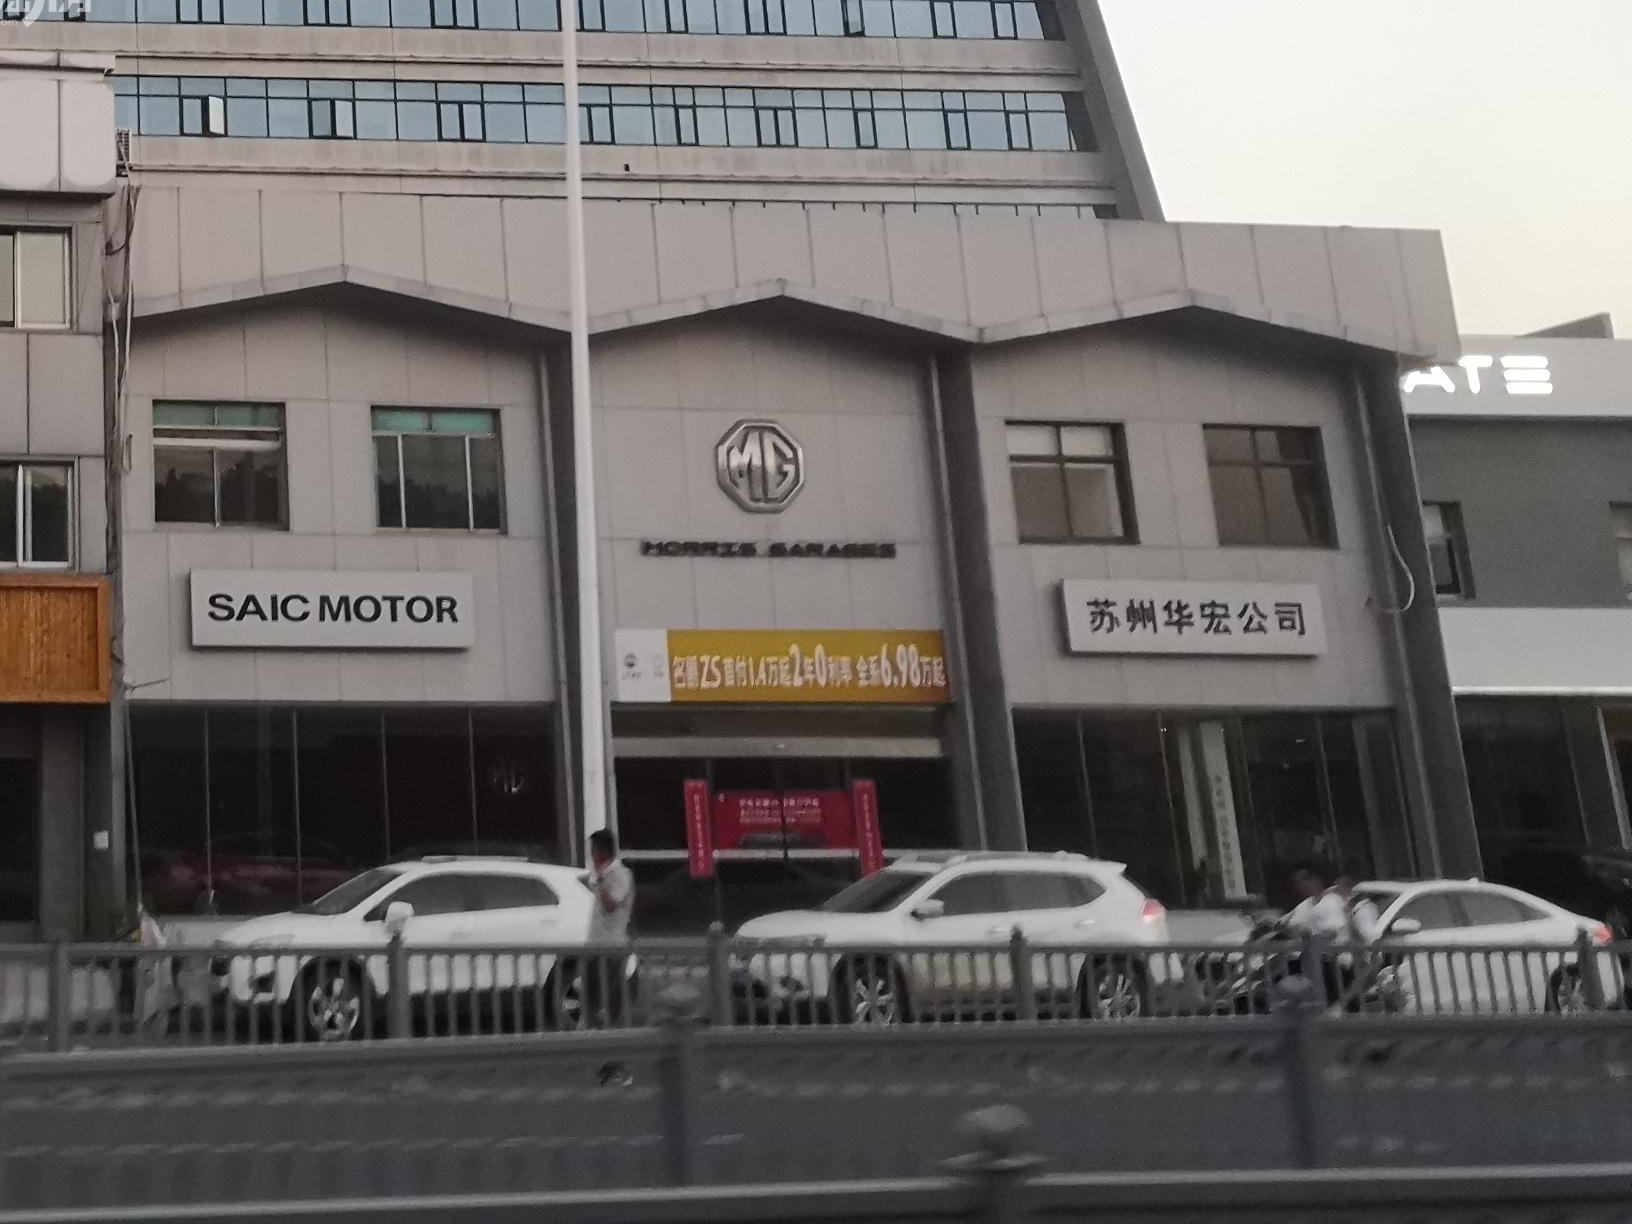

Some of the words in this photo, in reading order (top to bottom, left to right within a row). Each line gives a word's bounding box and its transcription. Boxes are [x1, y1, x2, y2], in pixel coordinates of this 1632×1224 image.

[726, 429, 798, 504] MG
[207, 593, 311, 622] SAIC
[318, 594, 459, 623] MOTOR
[1086, 598, 1306, 635] 苏州华宏公司
